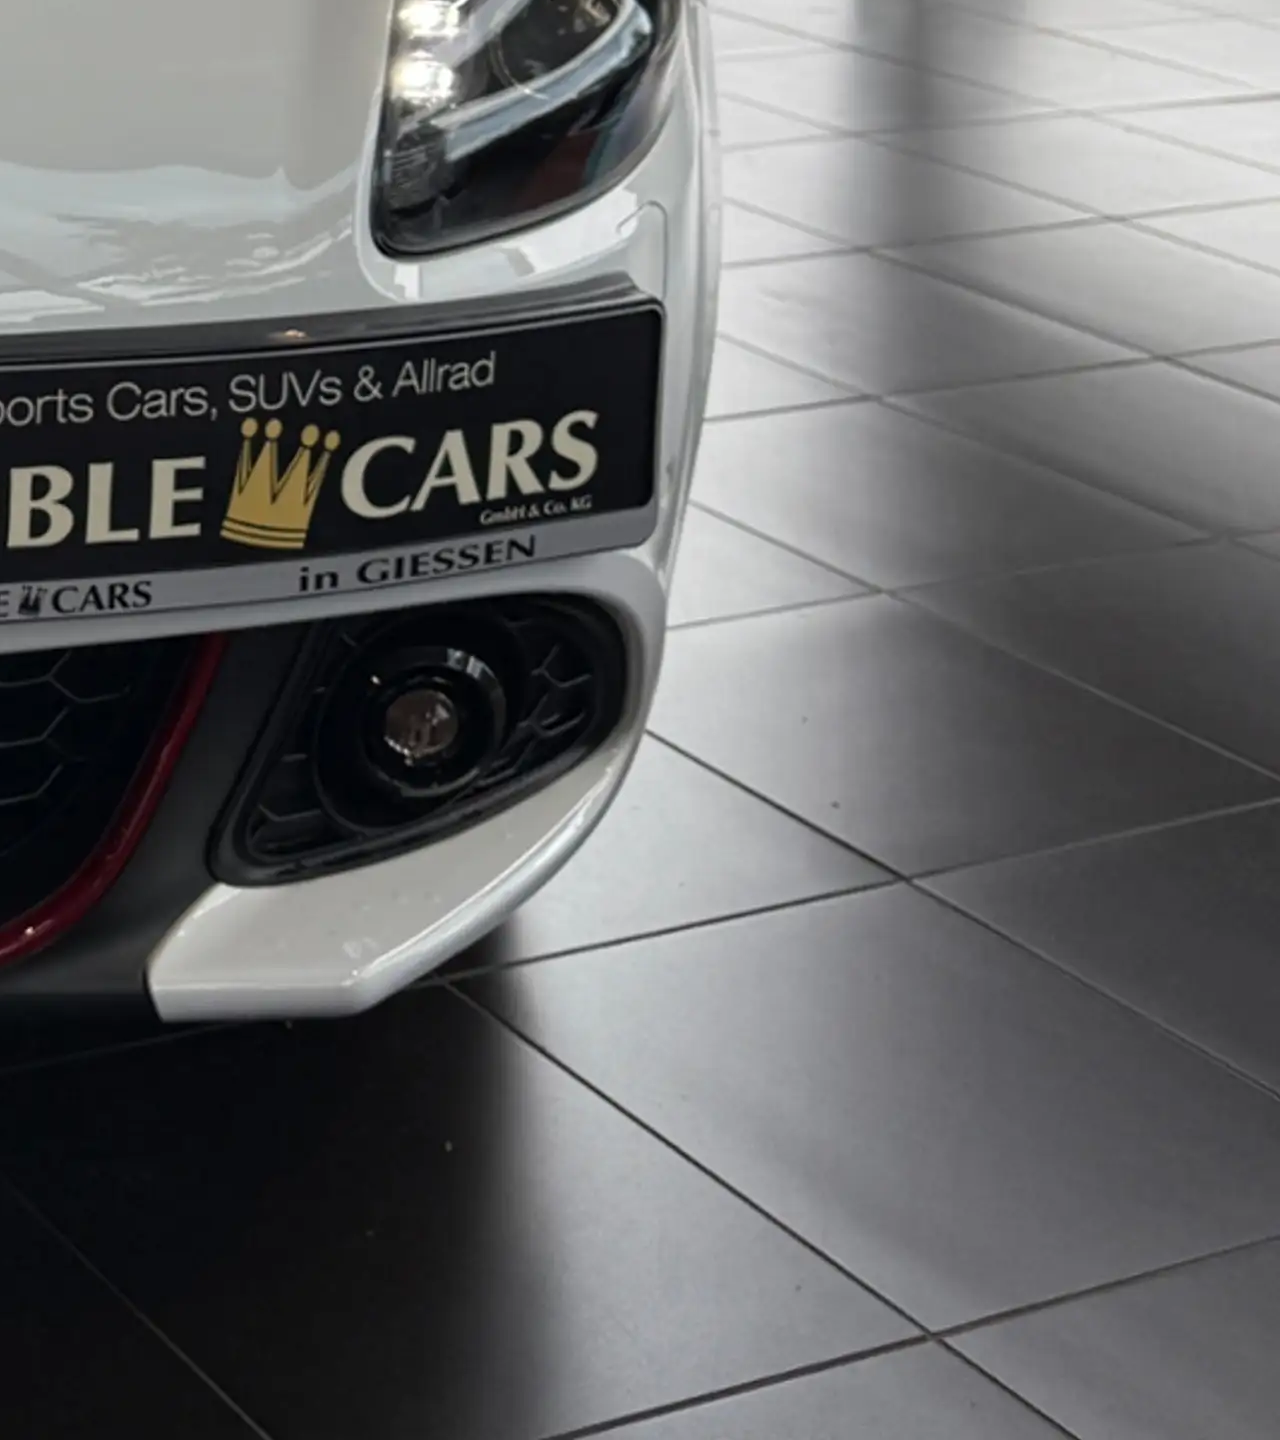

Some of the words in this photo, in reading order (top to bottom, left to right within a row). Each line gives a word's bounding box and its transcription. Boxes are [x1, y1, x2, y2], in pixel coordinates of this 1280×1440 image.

[105, 381, 218, 421] Cars,
[227, 368, 342, 413] SUVs
[352, 364, 385, 403] &
[391, 350, 497, 398] Allrad
[340, 409, 600, 519] CARS
[51, 580, 153, 614] CARS
[298, 566, 340, 592] in
[356, 534, 537, 585] GIESSEN
